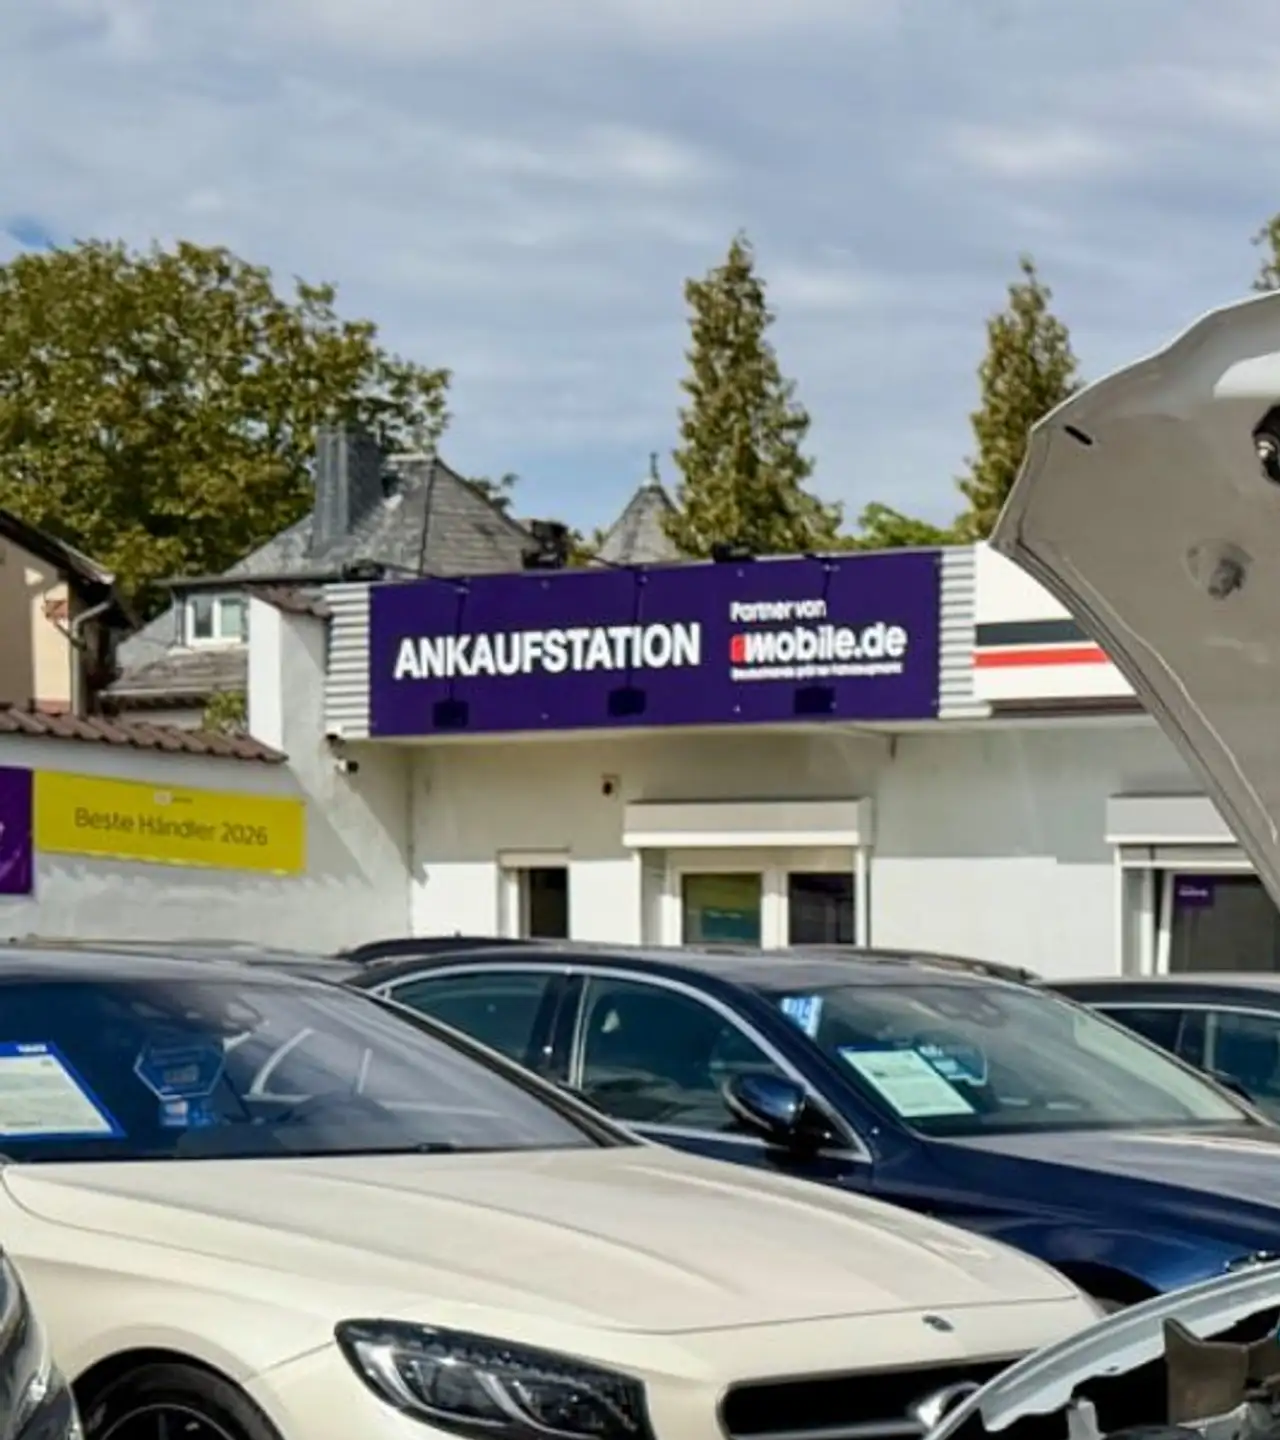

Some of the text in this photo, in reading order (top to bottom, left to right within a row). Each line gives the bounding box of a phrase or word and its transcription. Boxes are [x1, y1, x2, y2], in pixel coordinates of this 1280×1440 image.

[393, 622, 701, 679] ANKAUFSTATION
[74, 806, 268, 846] Beste Händler 2026
